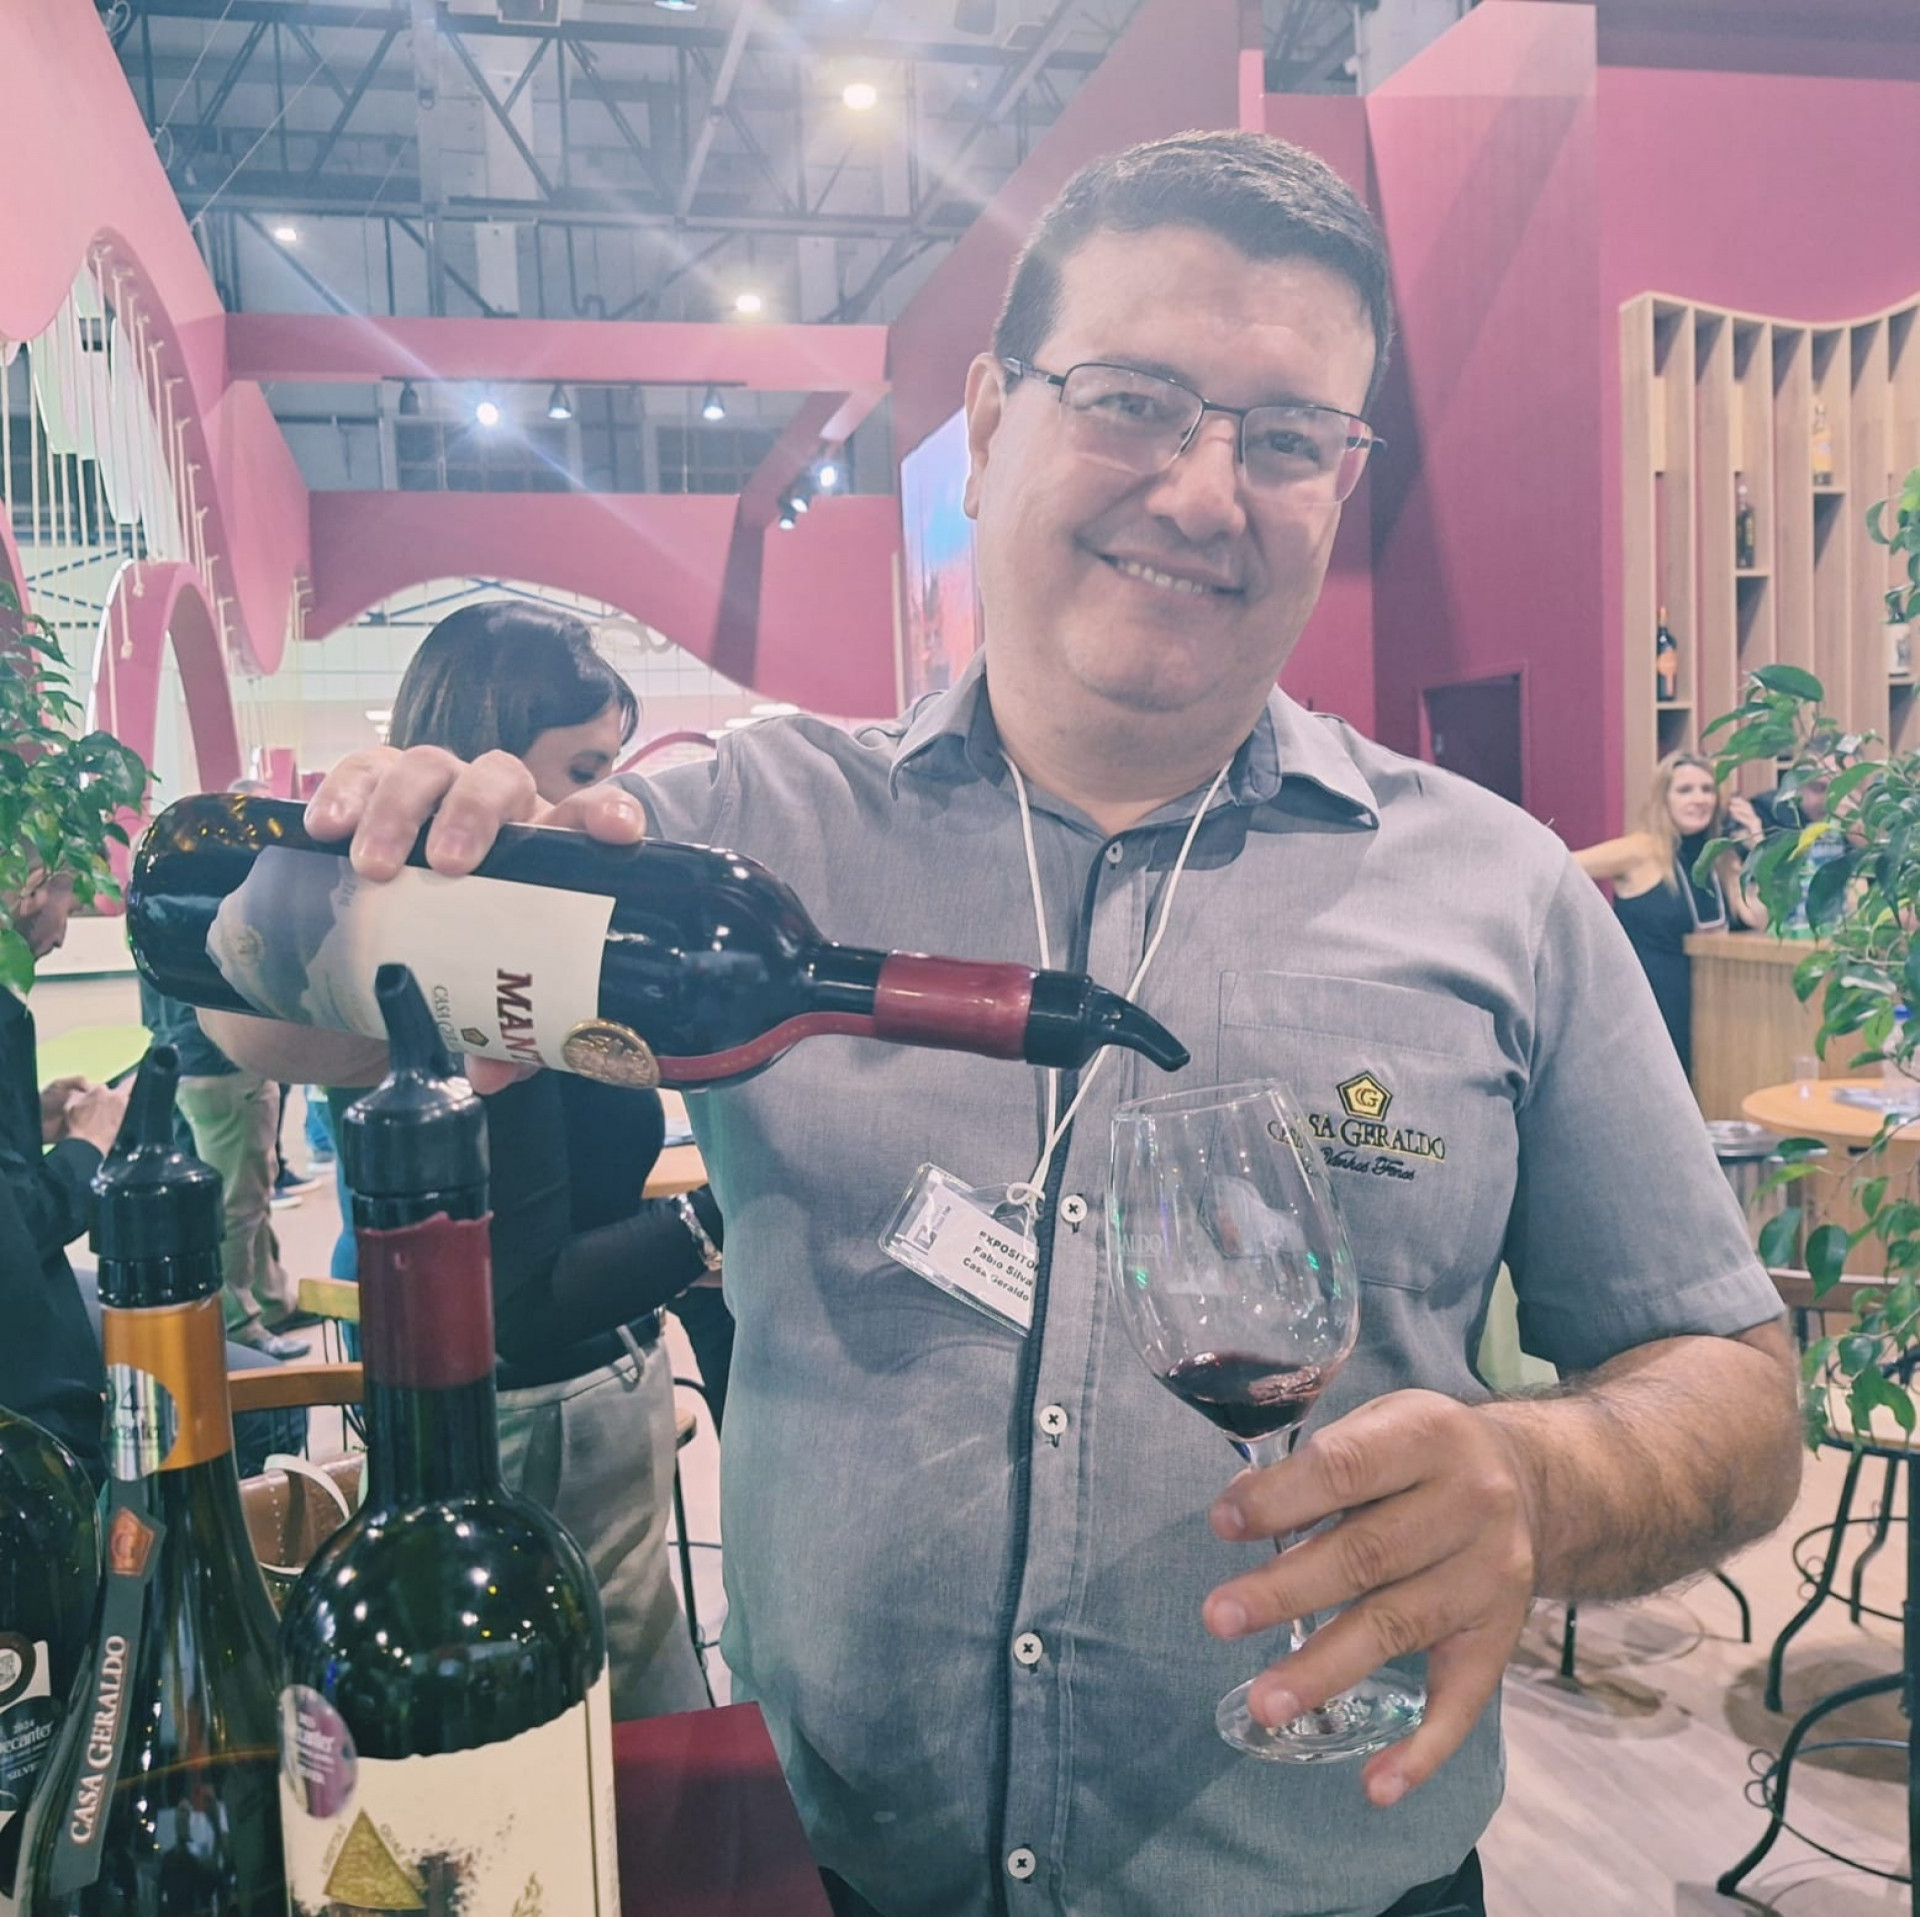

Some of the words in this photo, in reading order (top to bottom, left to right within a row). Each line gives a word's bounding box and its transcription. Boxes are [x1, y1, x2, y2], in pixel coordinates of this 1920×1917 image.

[1340, 1118, 1446, 1161] GERALDO
[962, 1257, 987, 1277] Casa
[990, 1273, 1030, 1302] Geraldo
[972, 1245, 1004, 1270] Fabio
[1006, 1265, 1034, 1287] Silva
[87, 1635, 127, 1770] GERALDO
[70, 1773, 105, 1845] CASA
